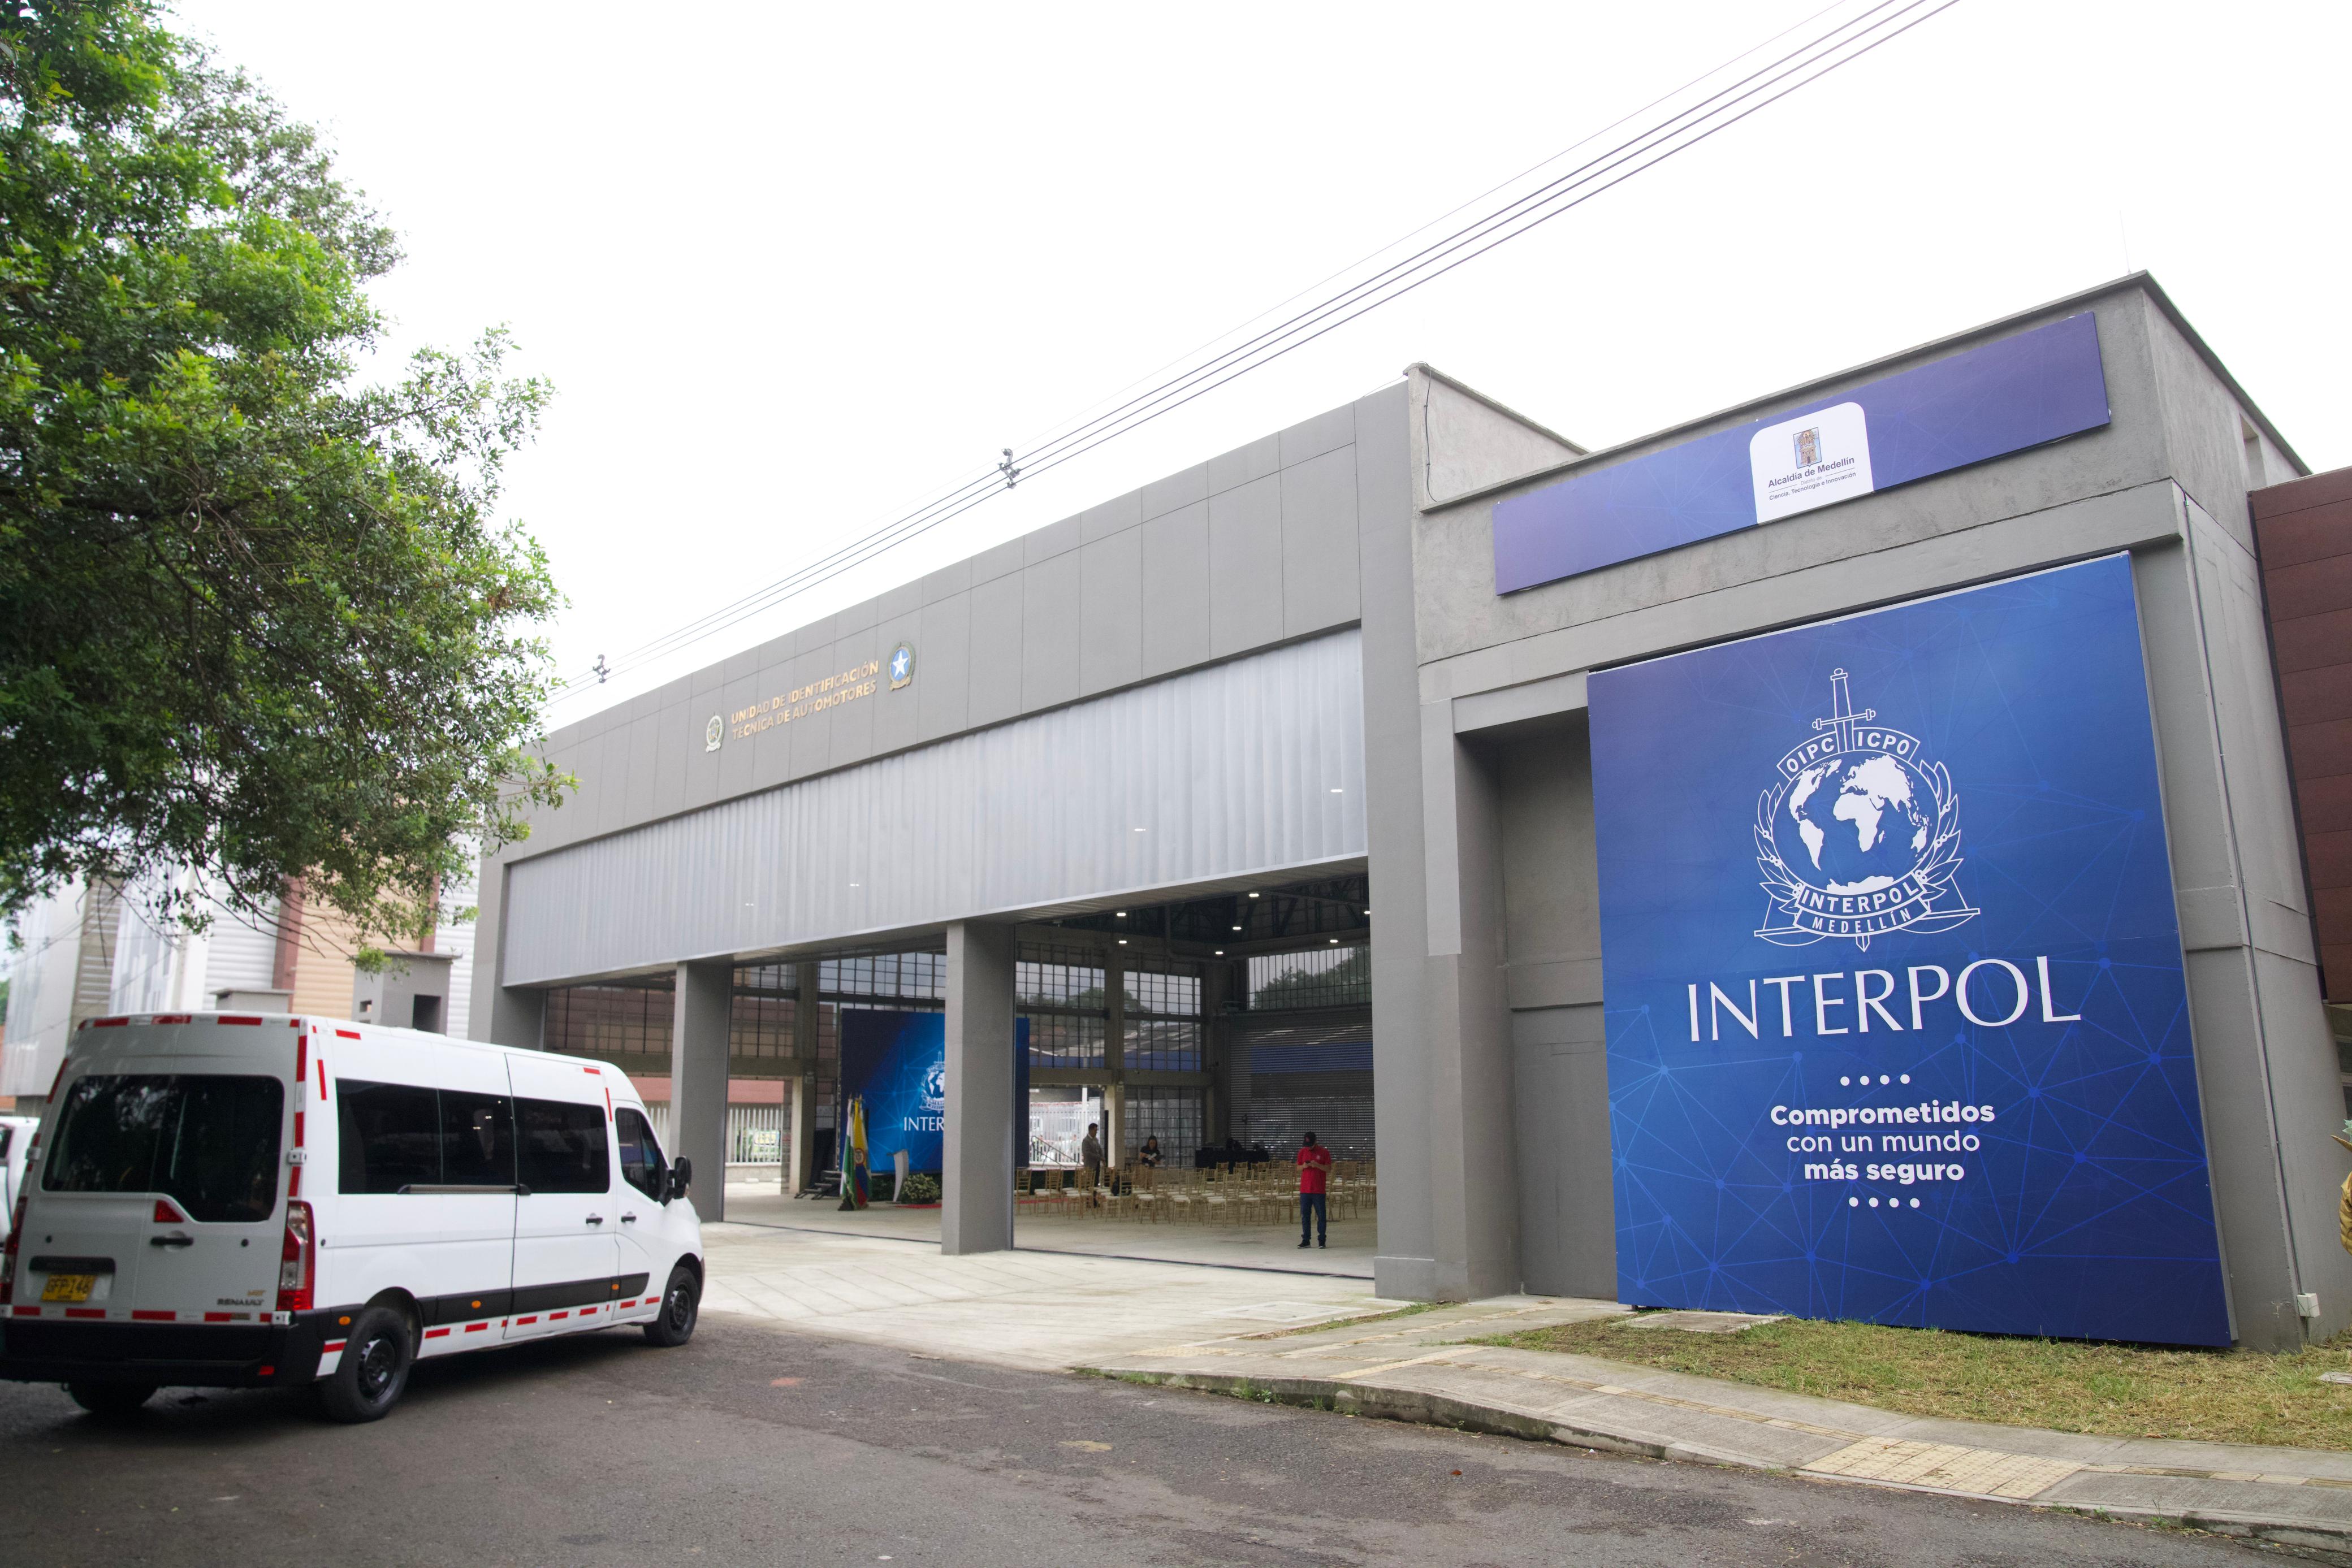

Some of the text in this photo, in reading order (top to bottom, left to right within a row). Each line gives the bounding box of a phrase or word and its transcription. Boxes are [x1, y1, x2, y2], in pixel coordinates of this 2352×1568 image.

[1768, 457, 1854, 488] Alcaldía de Medellín
[1769, 491, 1790, 501] Ciencia,
[1791, 481, 1821, 495] Tecnología
[1826, 471, 1856, 484] Innovación
[732, 660, 879, 724] UNIDAD DE IDENTIFICACIÓN
[777, 711, 790, 726] DE
[793, 679, 876, 720] AUTOMOTORES
[1786, 731, 1909, 773] OIPC ICPO
[1802, 881, 1919, 913] INTERPOL
[1812, 908, 1912, 934] MEDELLÍN
[1688, 955, 2082, 1042] INTERPOL
[904, 1117, 944, 1131] INTER
[1770, 1099, 1995, 1129] Comprometidos
[1787, 1130, 1980, 1152] con un mundo
[1804, 1158, 1965, 1185] más seguro
